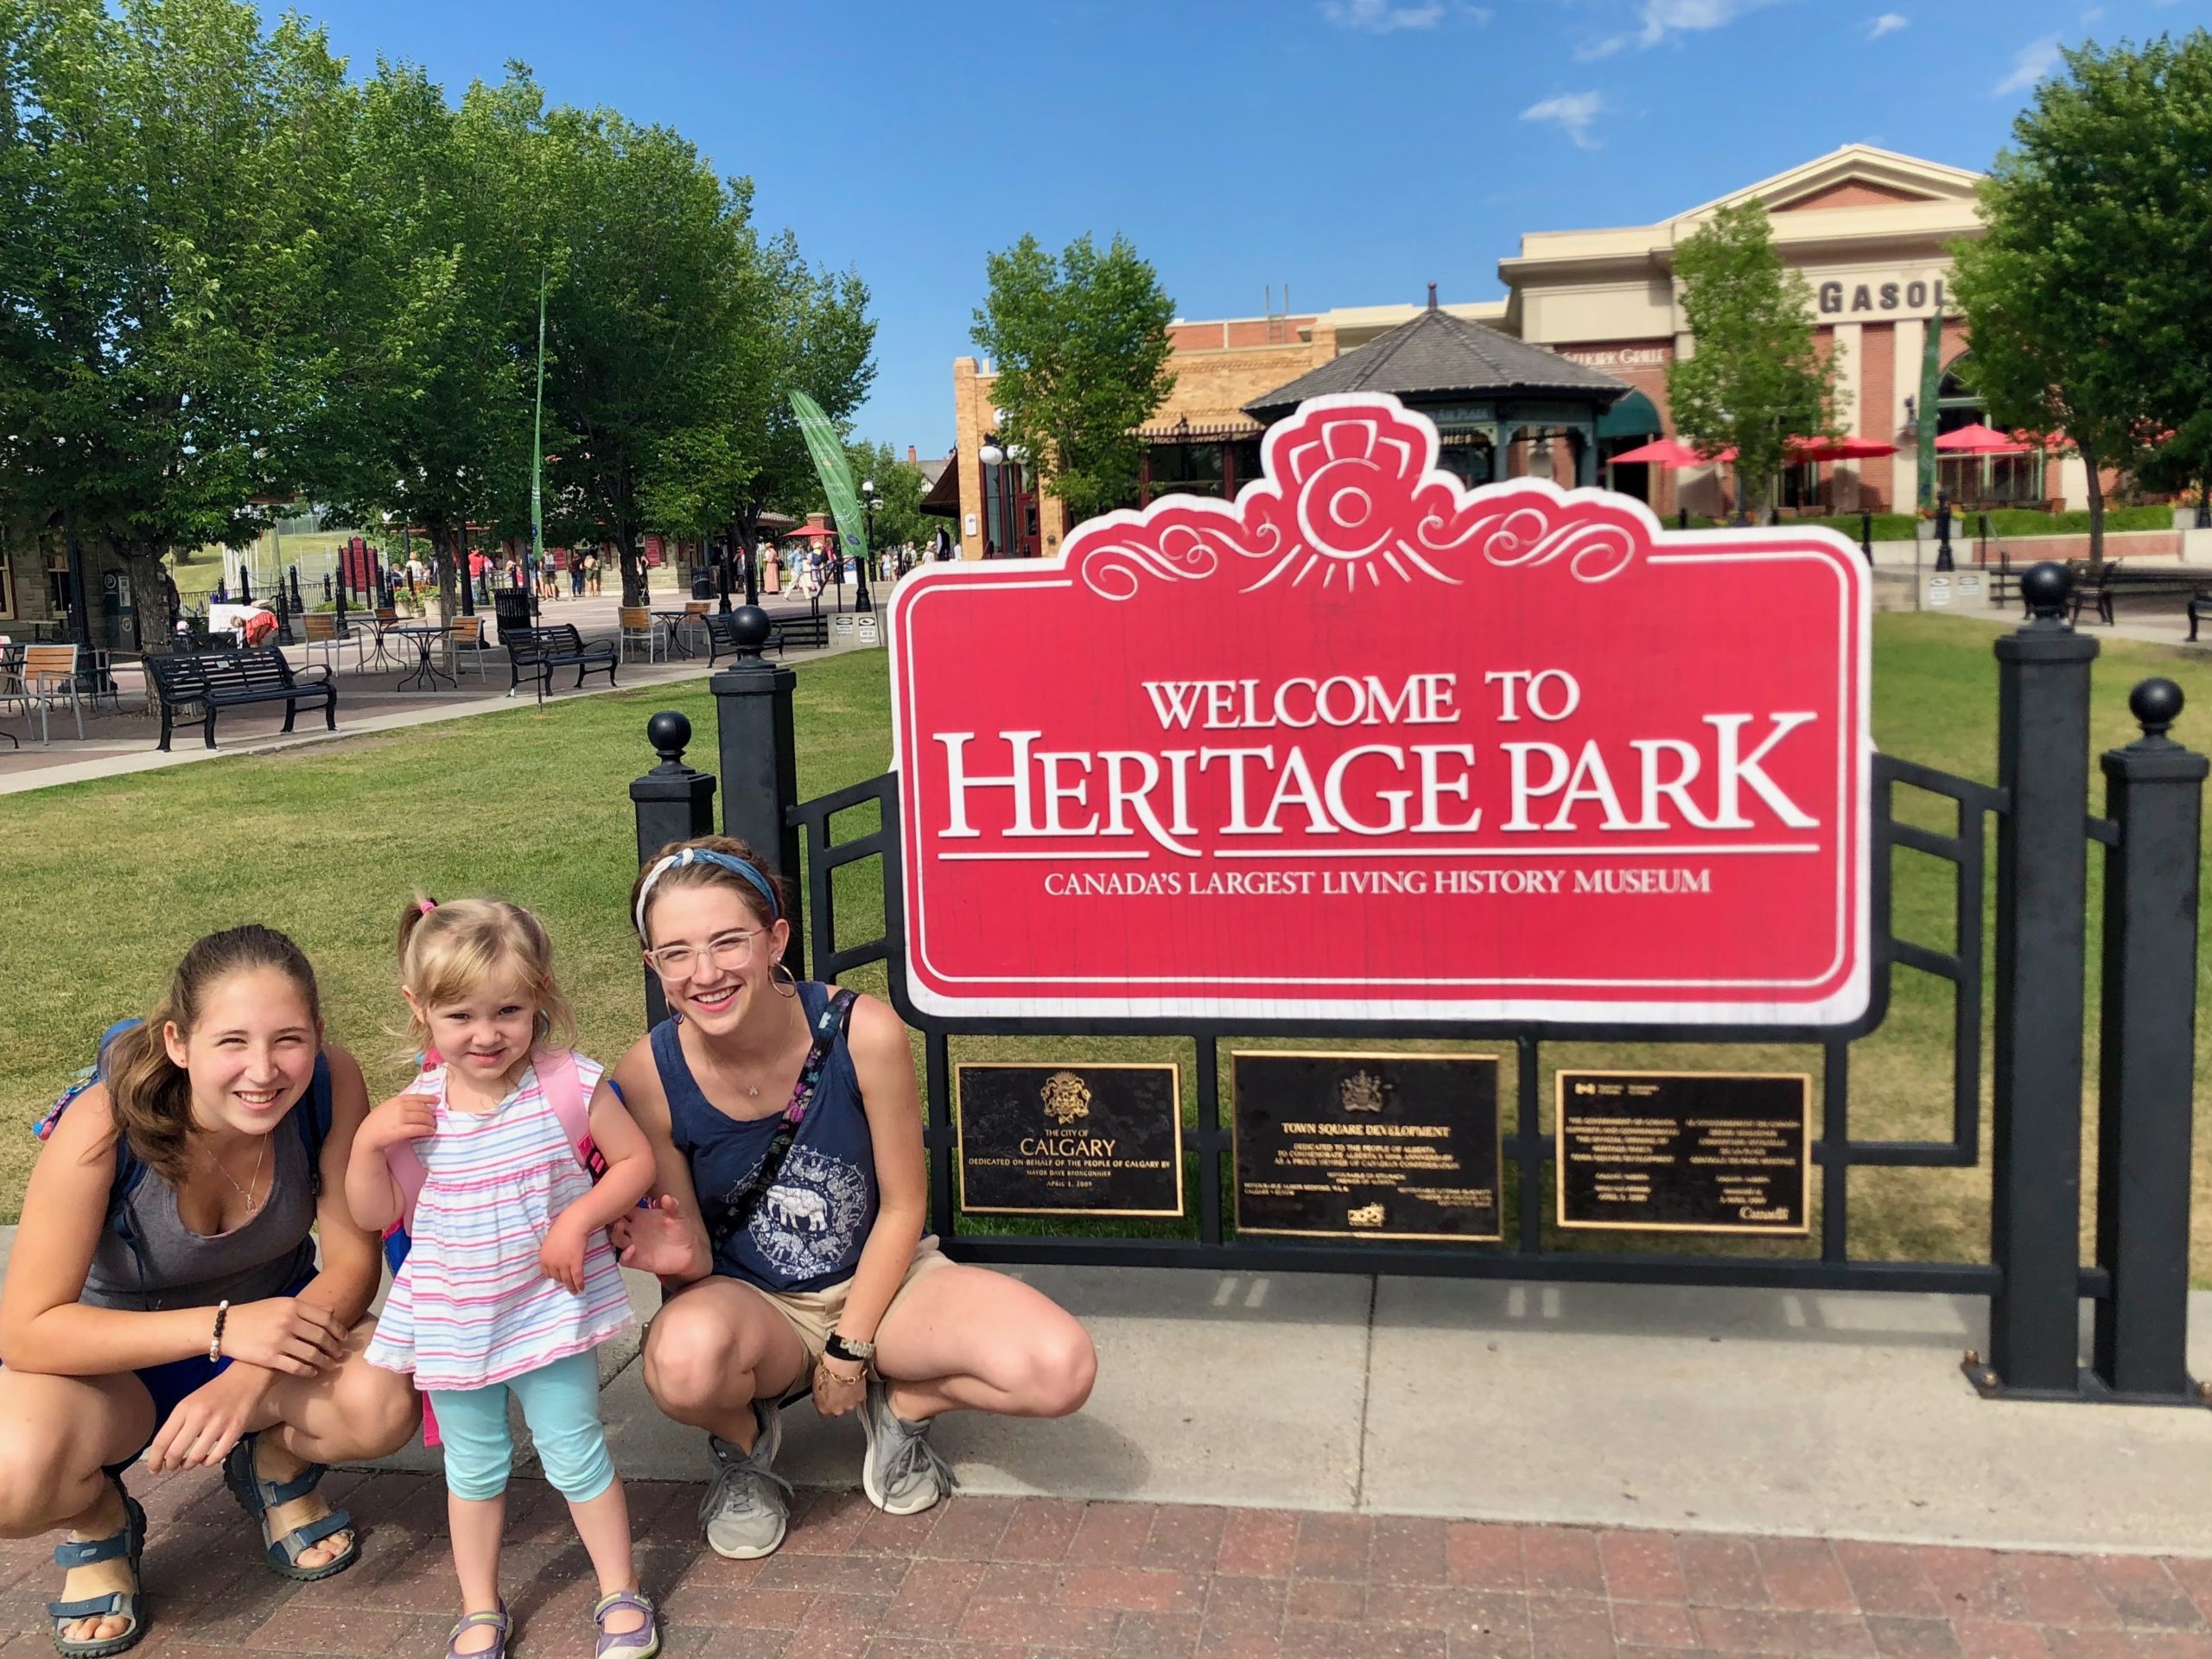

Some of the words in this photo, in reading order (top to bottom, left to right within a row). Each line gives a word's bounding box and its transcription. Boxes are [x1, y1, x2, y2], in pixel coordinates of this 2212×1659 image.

[1819, 280, 1950, 314] GASOL
[1141, 673, 1461, 730] WELCOME
[1484, 668, 1581, 722] TO
[932, 730, 1482, 856] HERITAGE
[1499, 711, 1820, 830] PARK
[1044, 871, 1181, 895] CANADA'S
[1189, 871, 1315, 895] LARGEST
[1321, 870, 1427, 894] LIVING
[1433, 869, 1564, 893] HISTORY
[1572, 868, 1713, 893] MUSEUM
[1045, 1128, 1059, 1137] THE
[1281, 1122, 1316, 1135] TOWN
[1318, 1123, 1364, 1136] SQUARE
[1365, 1124, 1452, 1138] DEVELOPMENT
[1020, 1138, 1116, 1157] CALGARY
